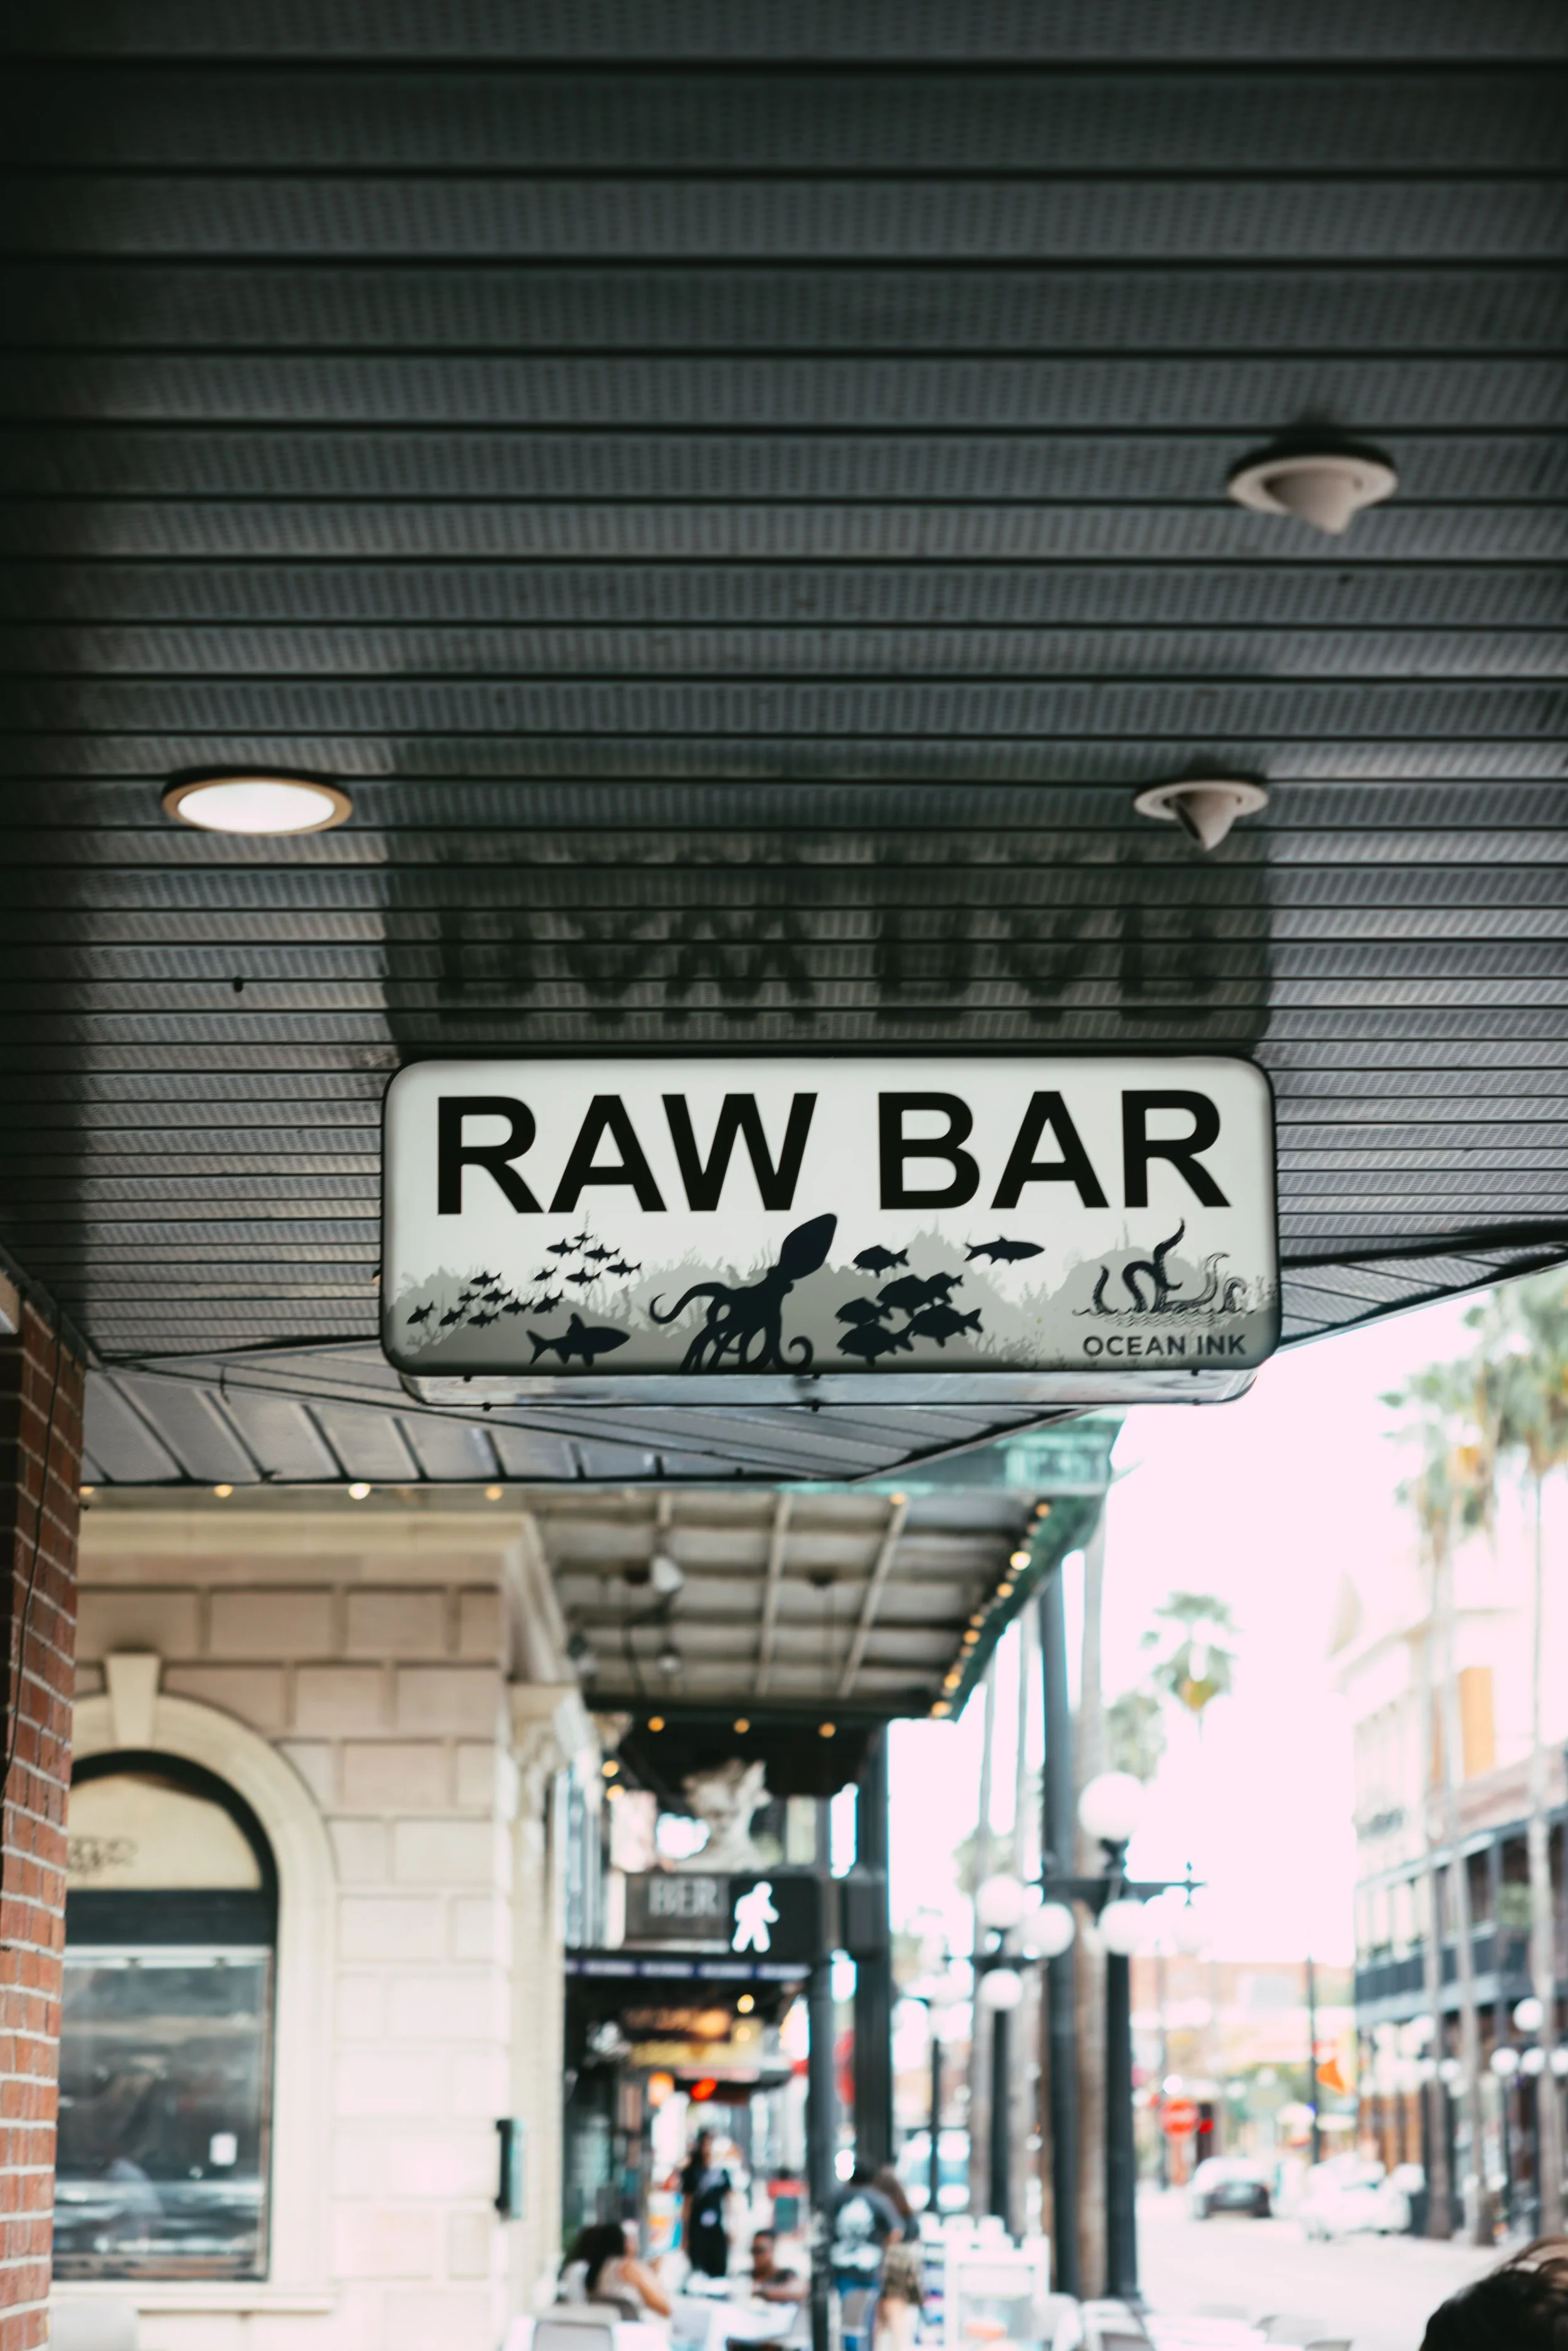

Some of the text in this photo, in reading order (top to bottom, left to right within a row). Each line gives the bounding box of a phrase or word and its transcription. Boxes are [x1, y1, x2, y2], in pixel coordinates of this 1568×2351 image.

[438, 1090, 1230, 1214] RAW BAR
[1083, 1334, 1247, 1357] OCEAN INK
